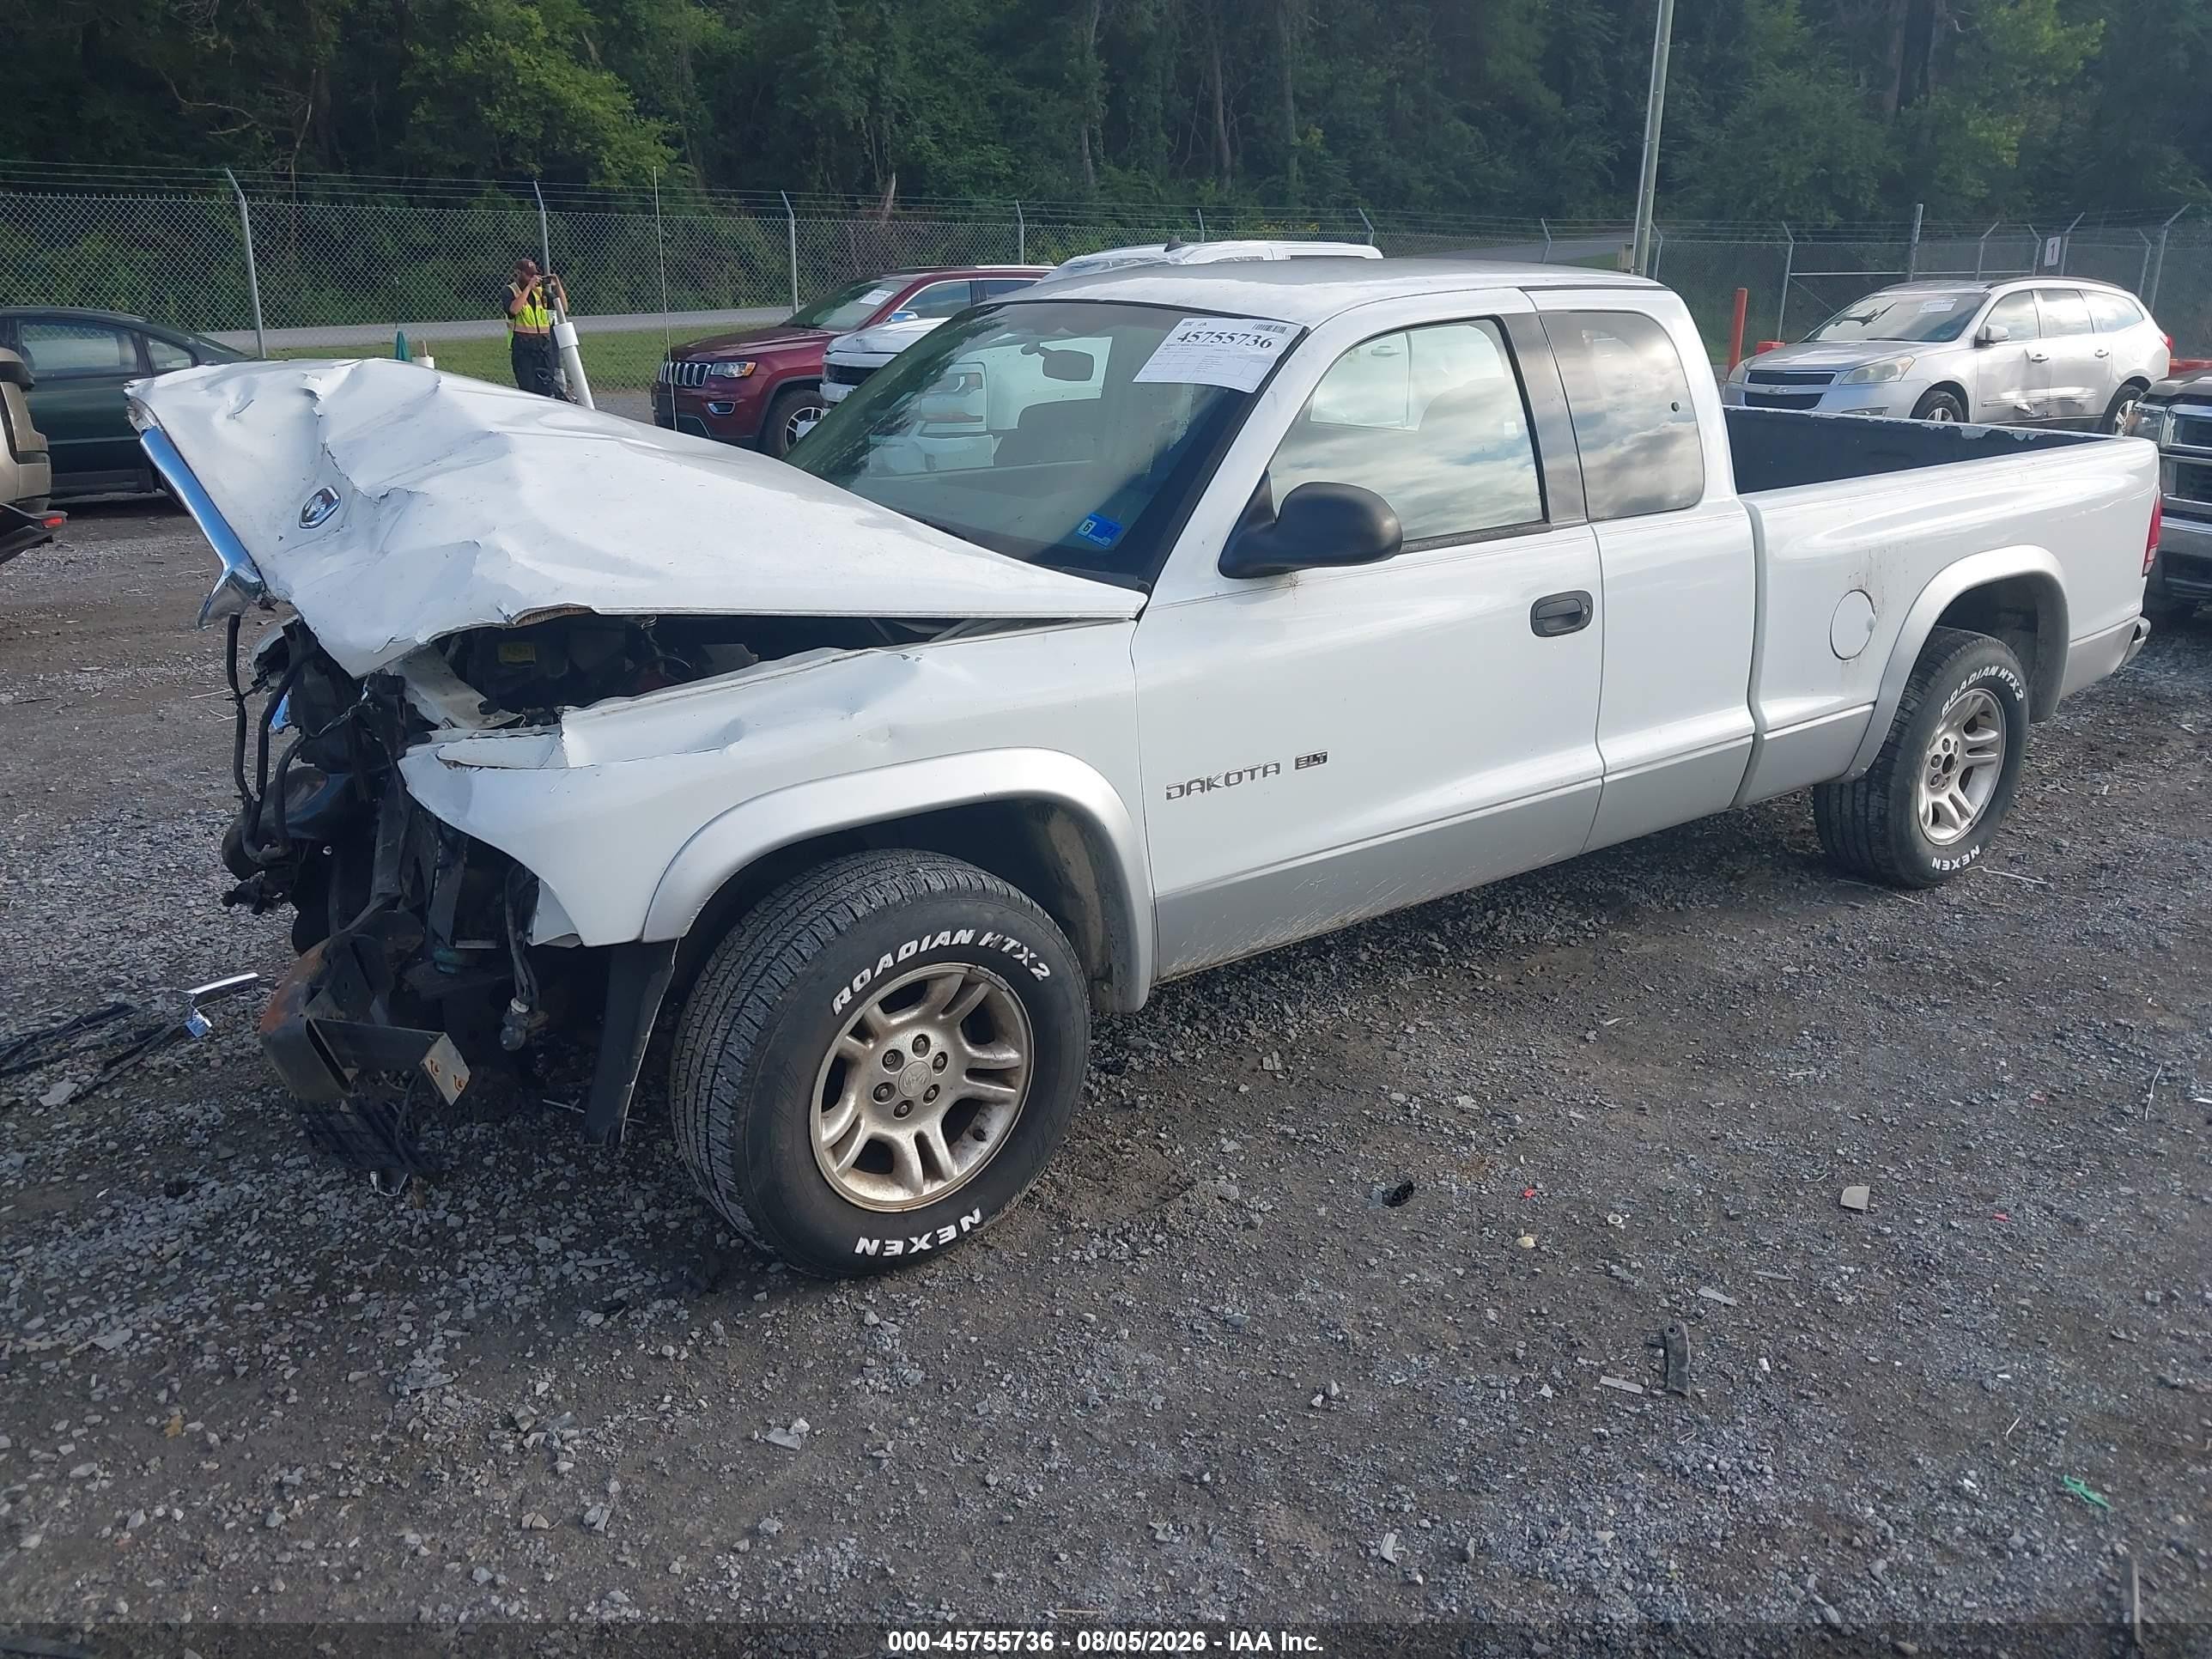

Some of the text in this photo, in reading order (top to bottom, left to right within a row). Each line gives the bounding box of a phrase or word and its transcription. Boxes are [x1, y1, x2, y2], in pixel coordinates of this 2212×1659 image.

[1176, 330, 1278, 349] 45755736
[1942, 665, 1999, 718] ROADIAN
[1165, 761, 1281, 800] DAKOTA
[1931, 844, 1980, 871] NEXEN
[831, 929, 1052, 1016] ROADIAN HTX2
[854, 1206, 983, 1256] NEXEN
